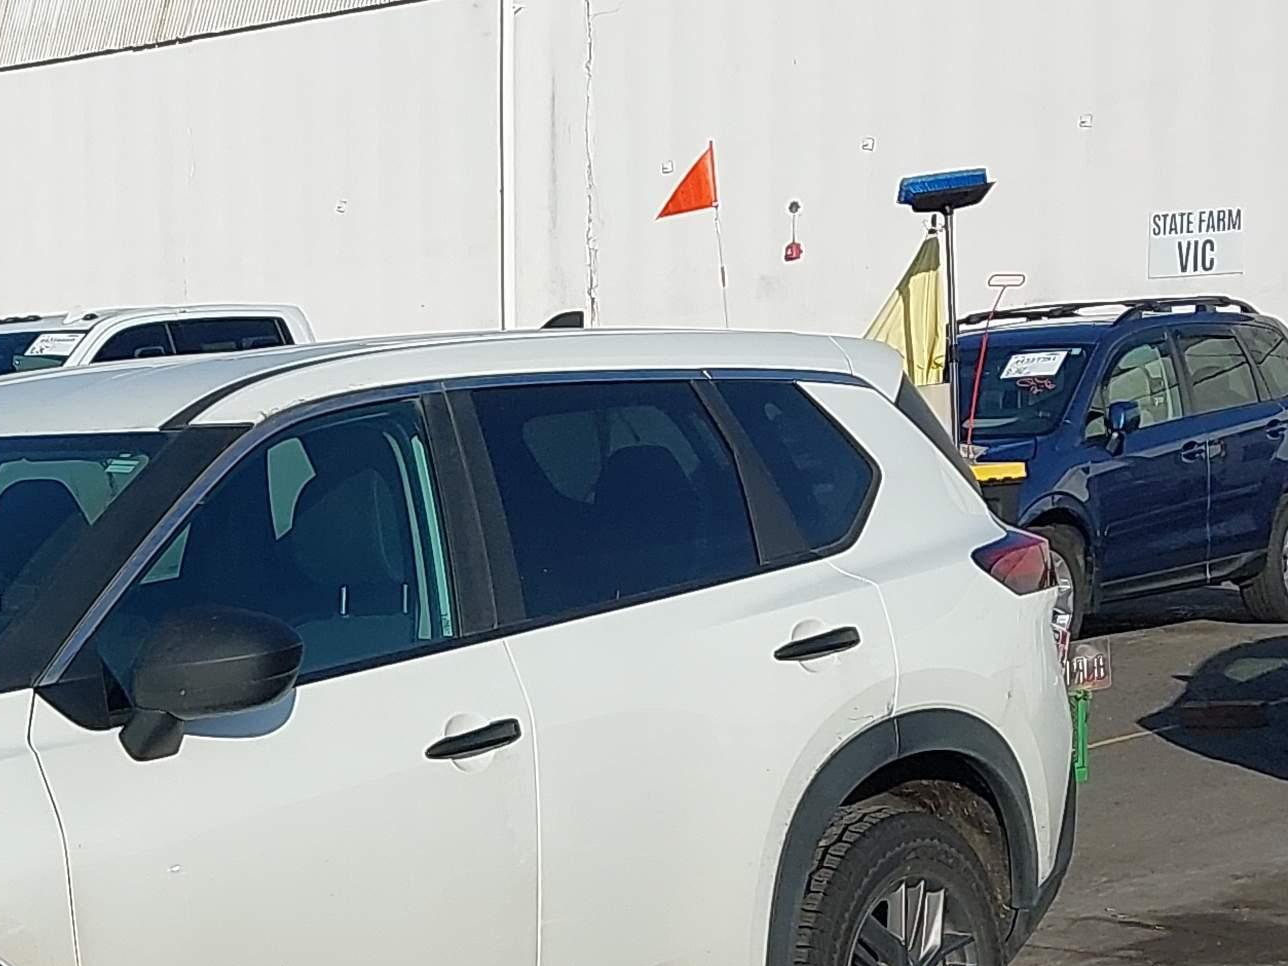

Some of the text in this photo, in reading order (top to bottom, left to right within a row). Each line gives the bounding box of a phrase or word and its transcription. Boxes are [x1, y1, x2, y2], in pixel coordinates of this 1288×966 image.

[1152, 208, 1241, 236] STATE FARM
[1177, 239, 1215, 273] VIC
